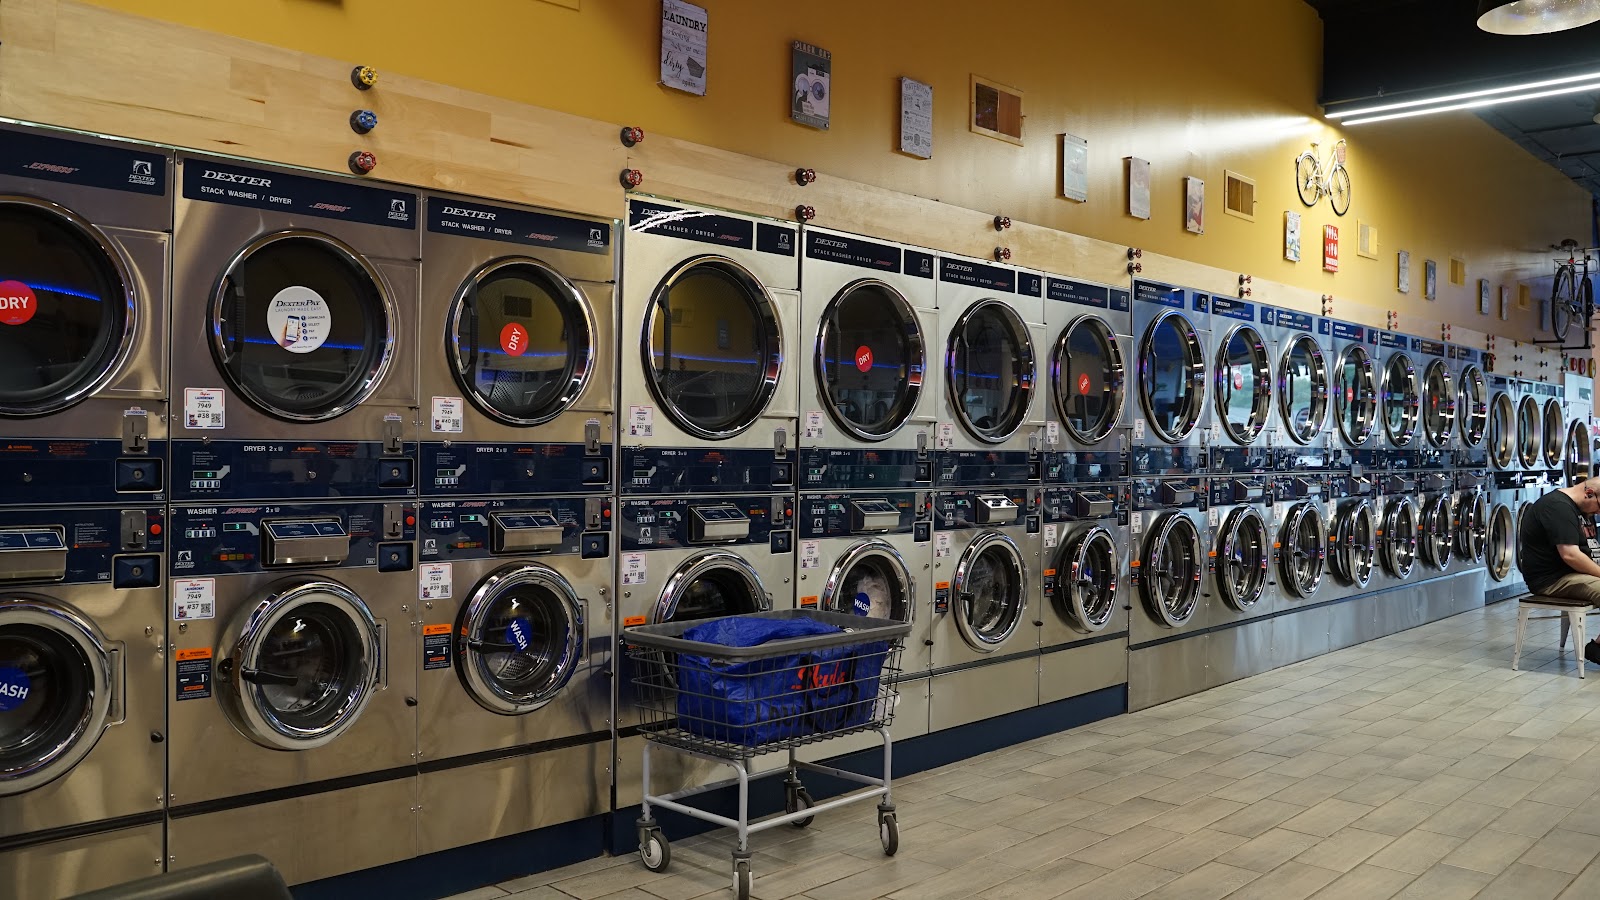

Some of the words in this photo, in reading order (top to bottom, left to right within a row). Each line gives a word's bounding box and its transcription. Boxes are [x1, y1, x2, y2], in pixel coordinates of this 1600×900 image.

[663, 10, 706, 32] LAUNDRY
[794, 41, 815, 55] BLACK
[128, 174, 155, 182] DEXTER
[201, 170, 272, 188] DEXTER
[201, 186, 225, 196] STACK
[228, 190, 257, 200] WASHER
[269, 196, 292, 205] DRYER
[442, 206, 497, 221] DEXTER
[641, 208, 683, 221] DER
[441, 220, 460, 229] STACK
[462, 223, 485, 232] WASHER
[494, 227, 512, 236] DRYER
[663, 224, 689, 233] WASHER
[696, 229, 715, 238] DRYER
[814, 237, 848, 249] DEXTER
[814, 248, 830, 256] STACK
[831, 251, 852, 259] WASHER
[946, 262, 973, 272] DEXTER
[1052, 282, 1074, 291] DEXTER
[0, 296, 29, 310] DRY
[508, 327, 522, 351] DRY
[858, 352, 871, 366] DRY
[854, 598, 871, 614] WASH
[510, 620, 528, 650] WASH
[0, 681, 29, 700] ASH
